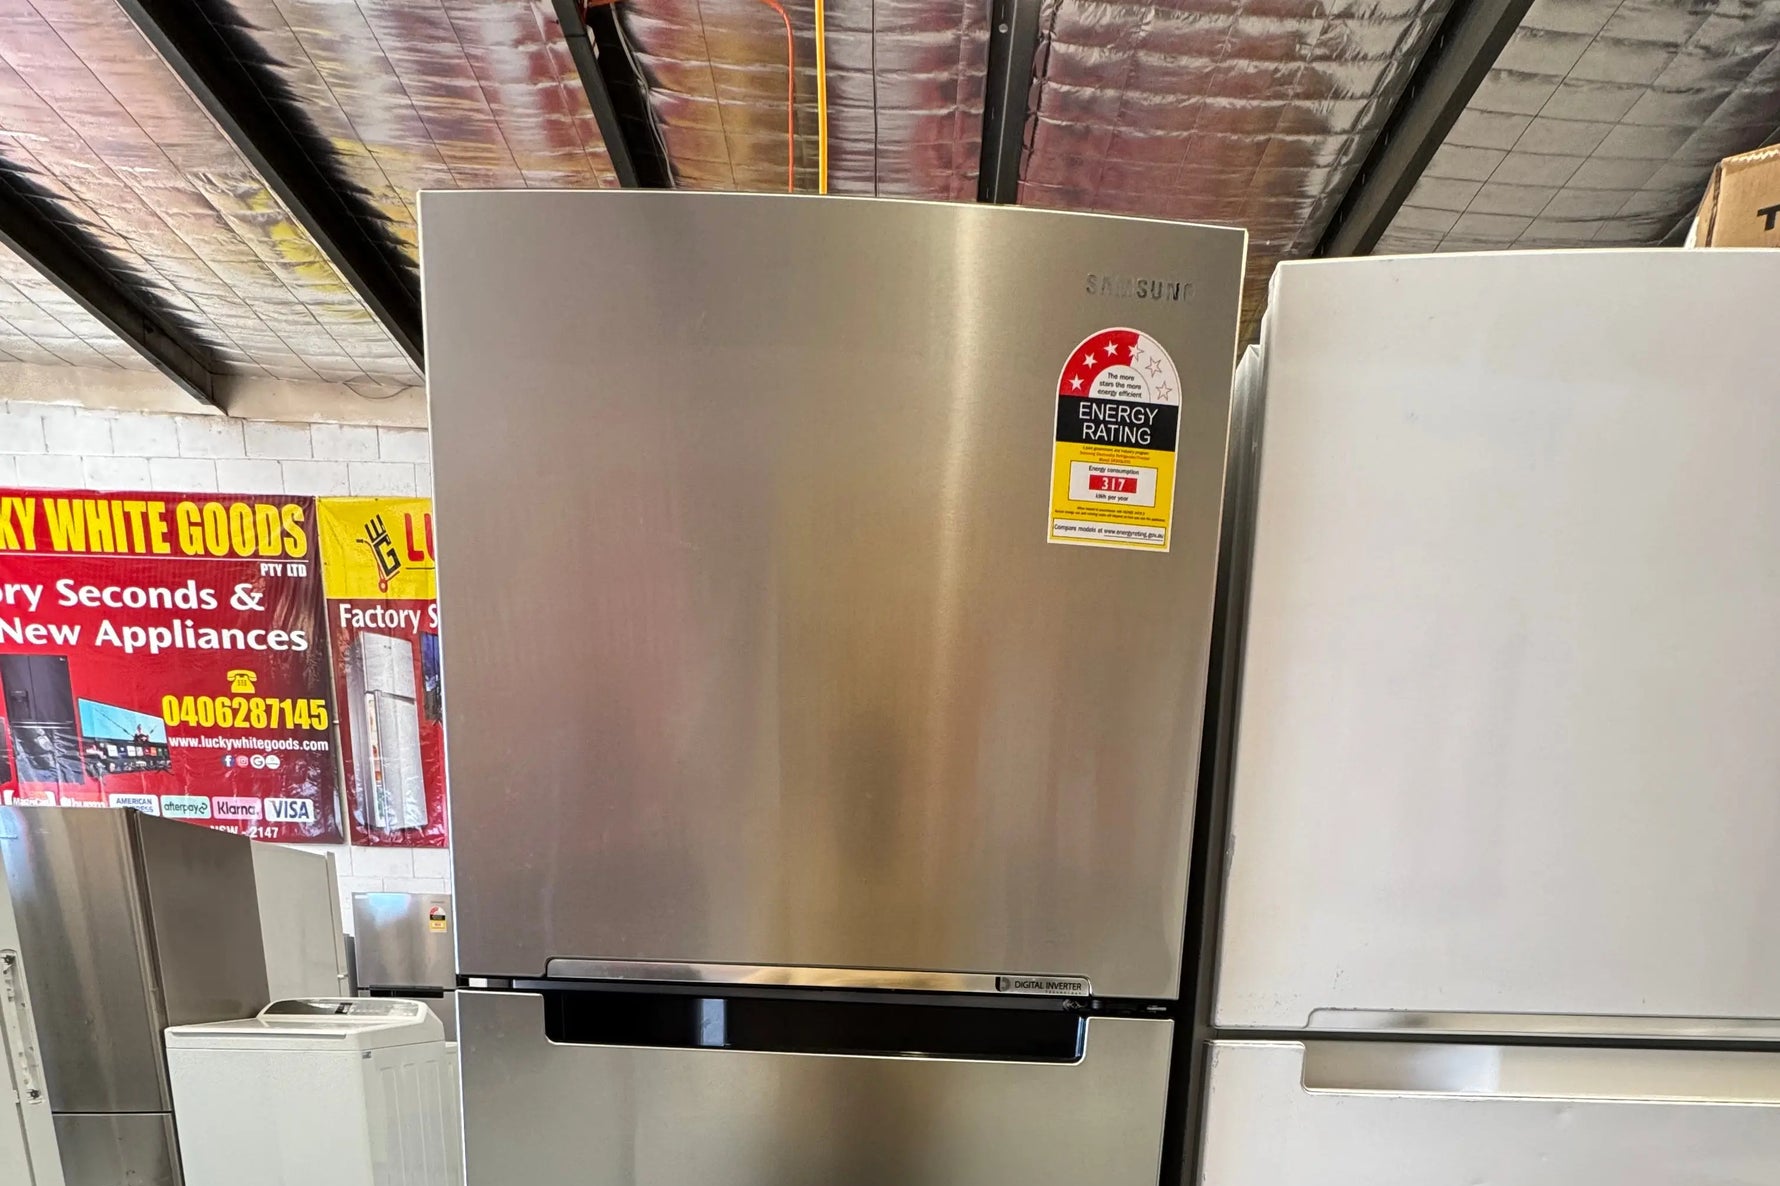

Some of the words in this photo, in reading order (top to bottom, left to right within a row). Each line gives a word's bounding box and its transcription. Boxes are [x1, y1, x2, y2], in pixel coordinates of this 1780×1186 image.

[1108, 372, 1118, 380] The
[1097, 389, 1117, 397] energy
[1079, 401, 1159, 426] ENERGY
[1082, 422, 1151, 445] RATING
[1088, 465, 1107, 473] Energy
[1101, 477, 1126, 491] 317
[0, 497, 36, 551] KY
[42, 498, 171, 554] WHITE
[176, 501, 308, 558] GOODS
[260, 563, 283, 576] PTY
[286, 564, 308, 577] LTD
[55, 578, 218, 610] Seconds
[230, 583, 265, 611] &
[339, 603, 421, 634] Factory
[0, 616, 81, 646] New
[94, 618, 308, 654] Appliances
[162, 695, 329, 730] 0406287145
[168, 735, 329, 751] www.luckywhitegoods.com
[116, 797, 152, 805] AMERICAN
[164, 802, 198, 814] afterpay
[272, 800, 310, 819] VISA
[249, 826, 279, 838] 2147
[1014, 980, 1044, 989] DIGITAL
[1045, 982, 1082, 991] INVERTER
